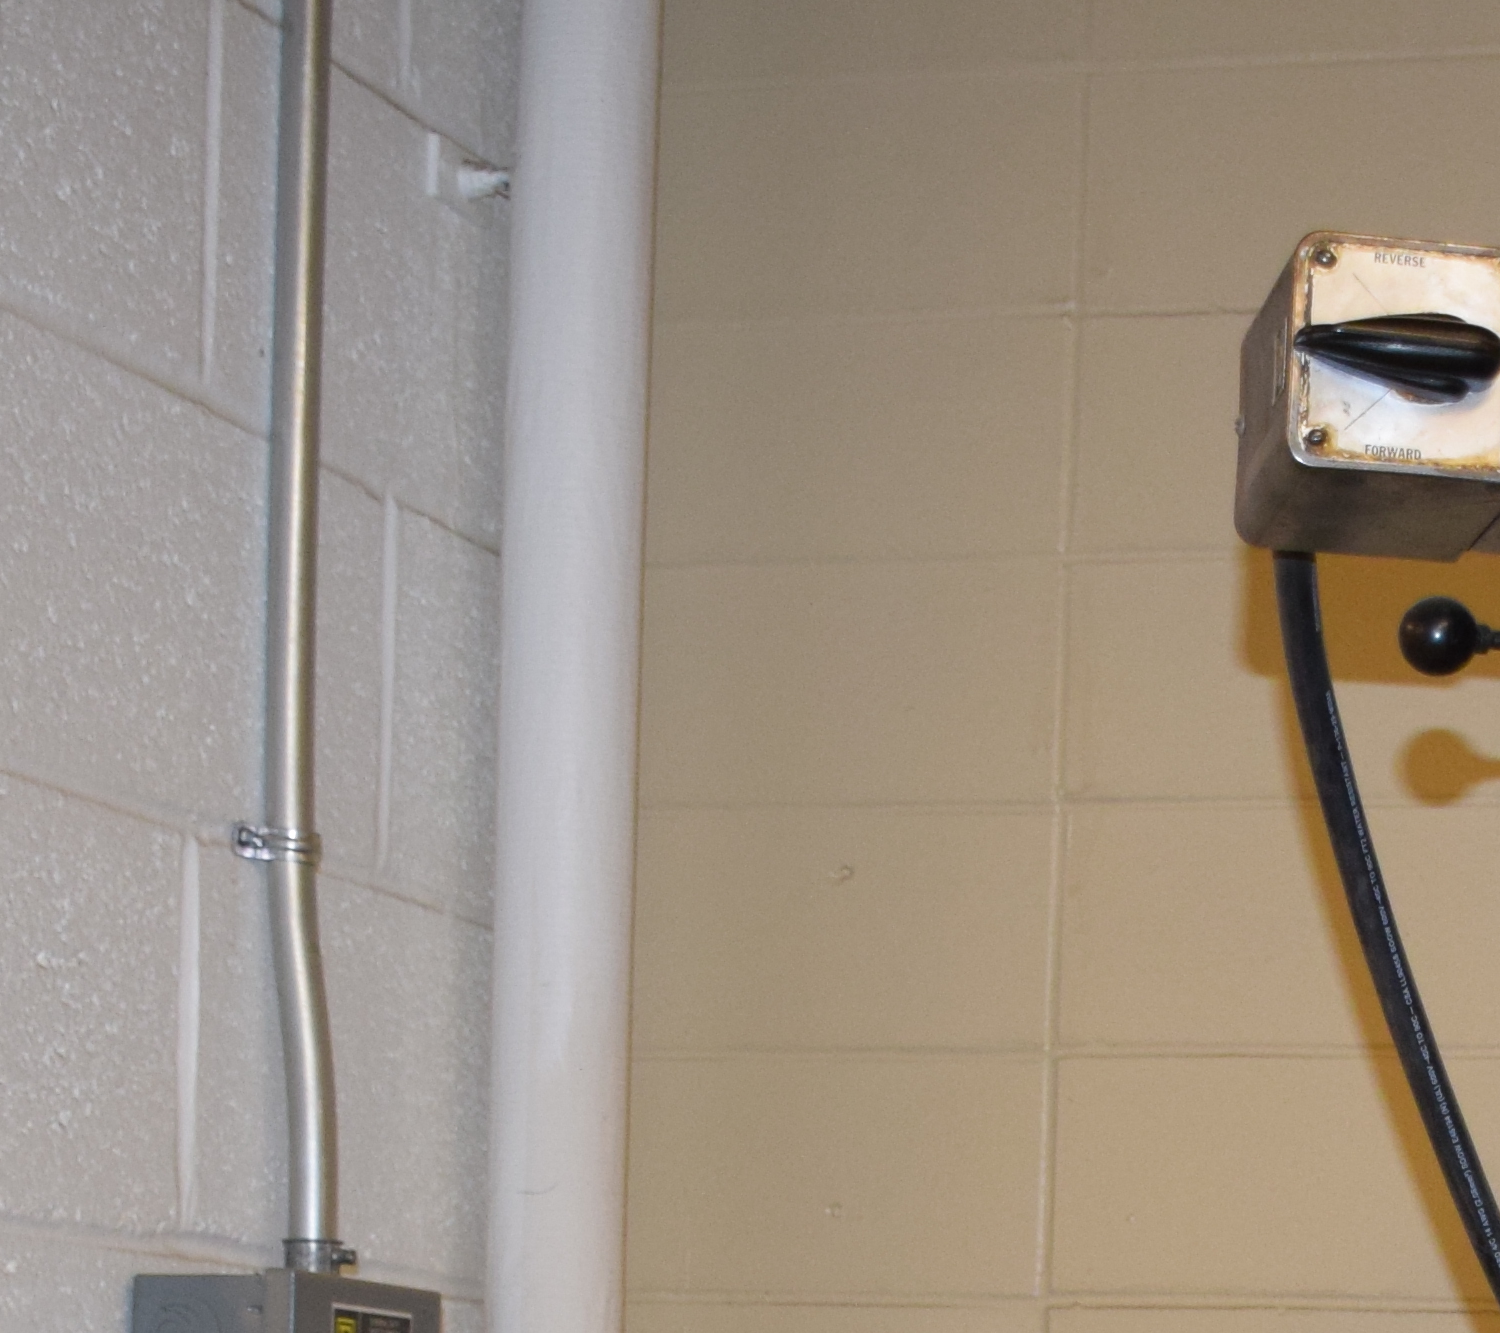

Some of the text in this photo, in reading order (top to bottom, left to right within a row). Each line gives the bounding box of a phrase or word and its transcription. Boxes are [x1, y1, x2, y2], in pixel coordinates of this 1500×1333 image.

[1374, 252, 1426, 268] REVERSE
[1364, 444, 1422, 460] FORWARD
[1351, 806, 1365, 836] WATER
[1368, 870, 1377, 884] TO
[1401, 986, 1413, 1005] CSA
[1415, 1031, 1425, 1043] TO
[1454, 1143, 1469, 1169] SOOW
[1477, 1207, 1489, 1227] AWG
[1484, 1227, 1493, 1237] 14
